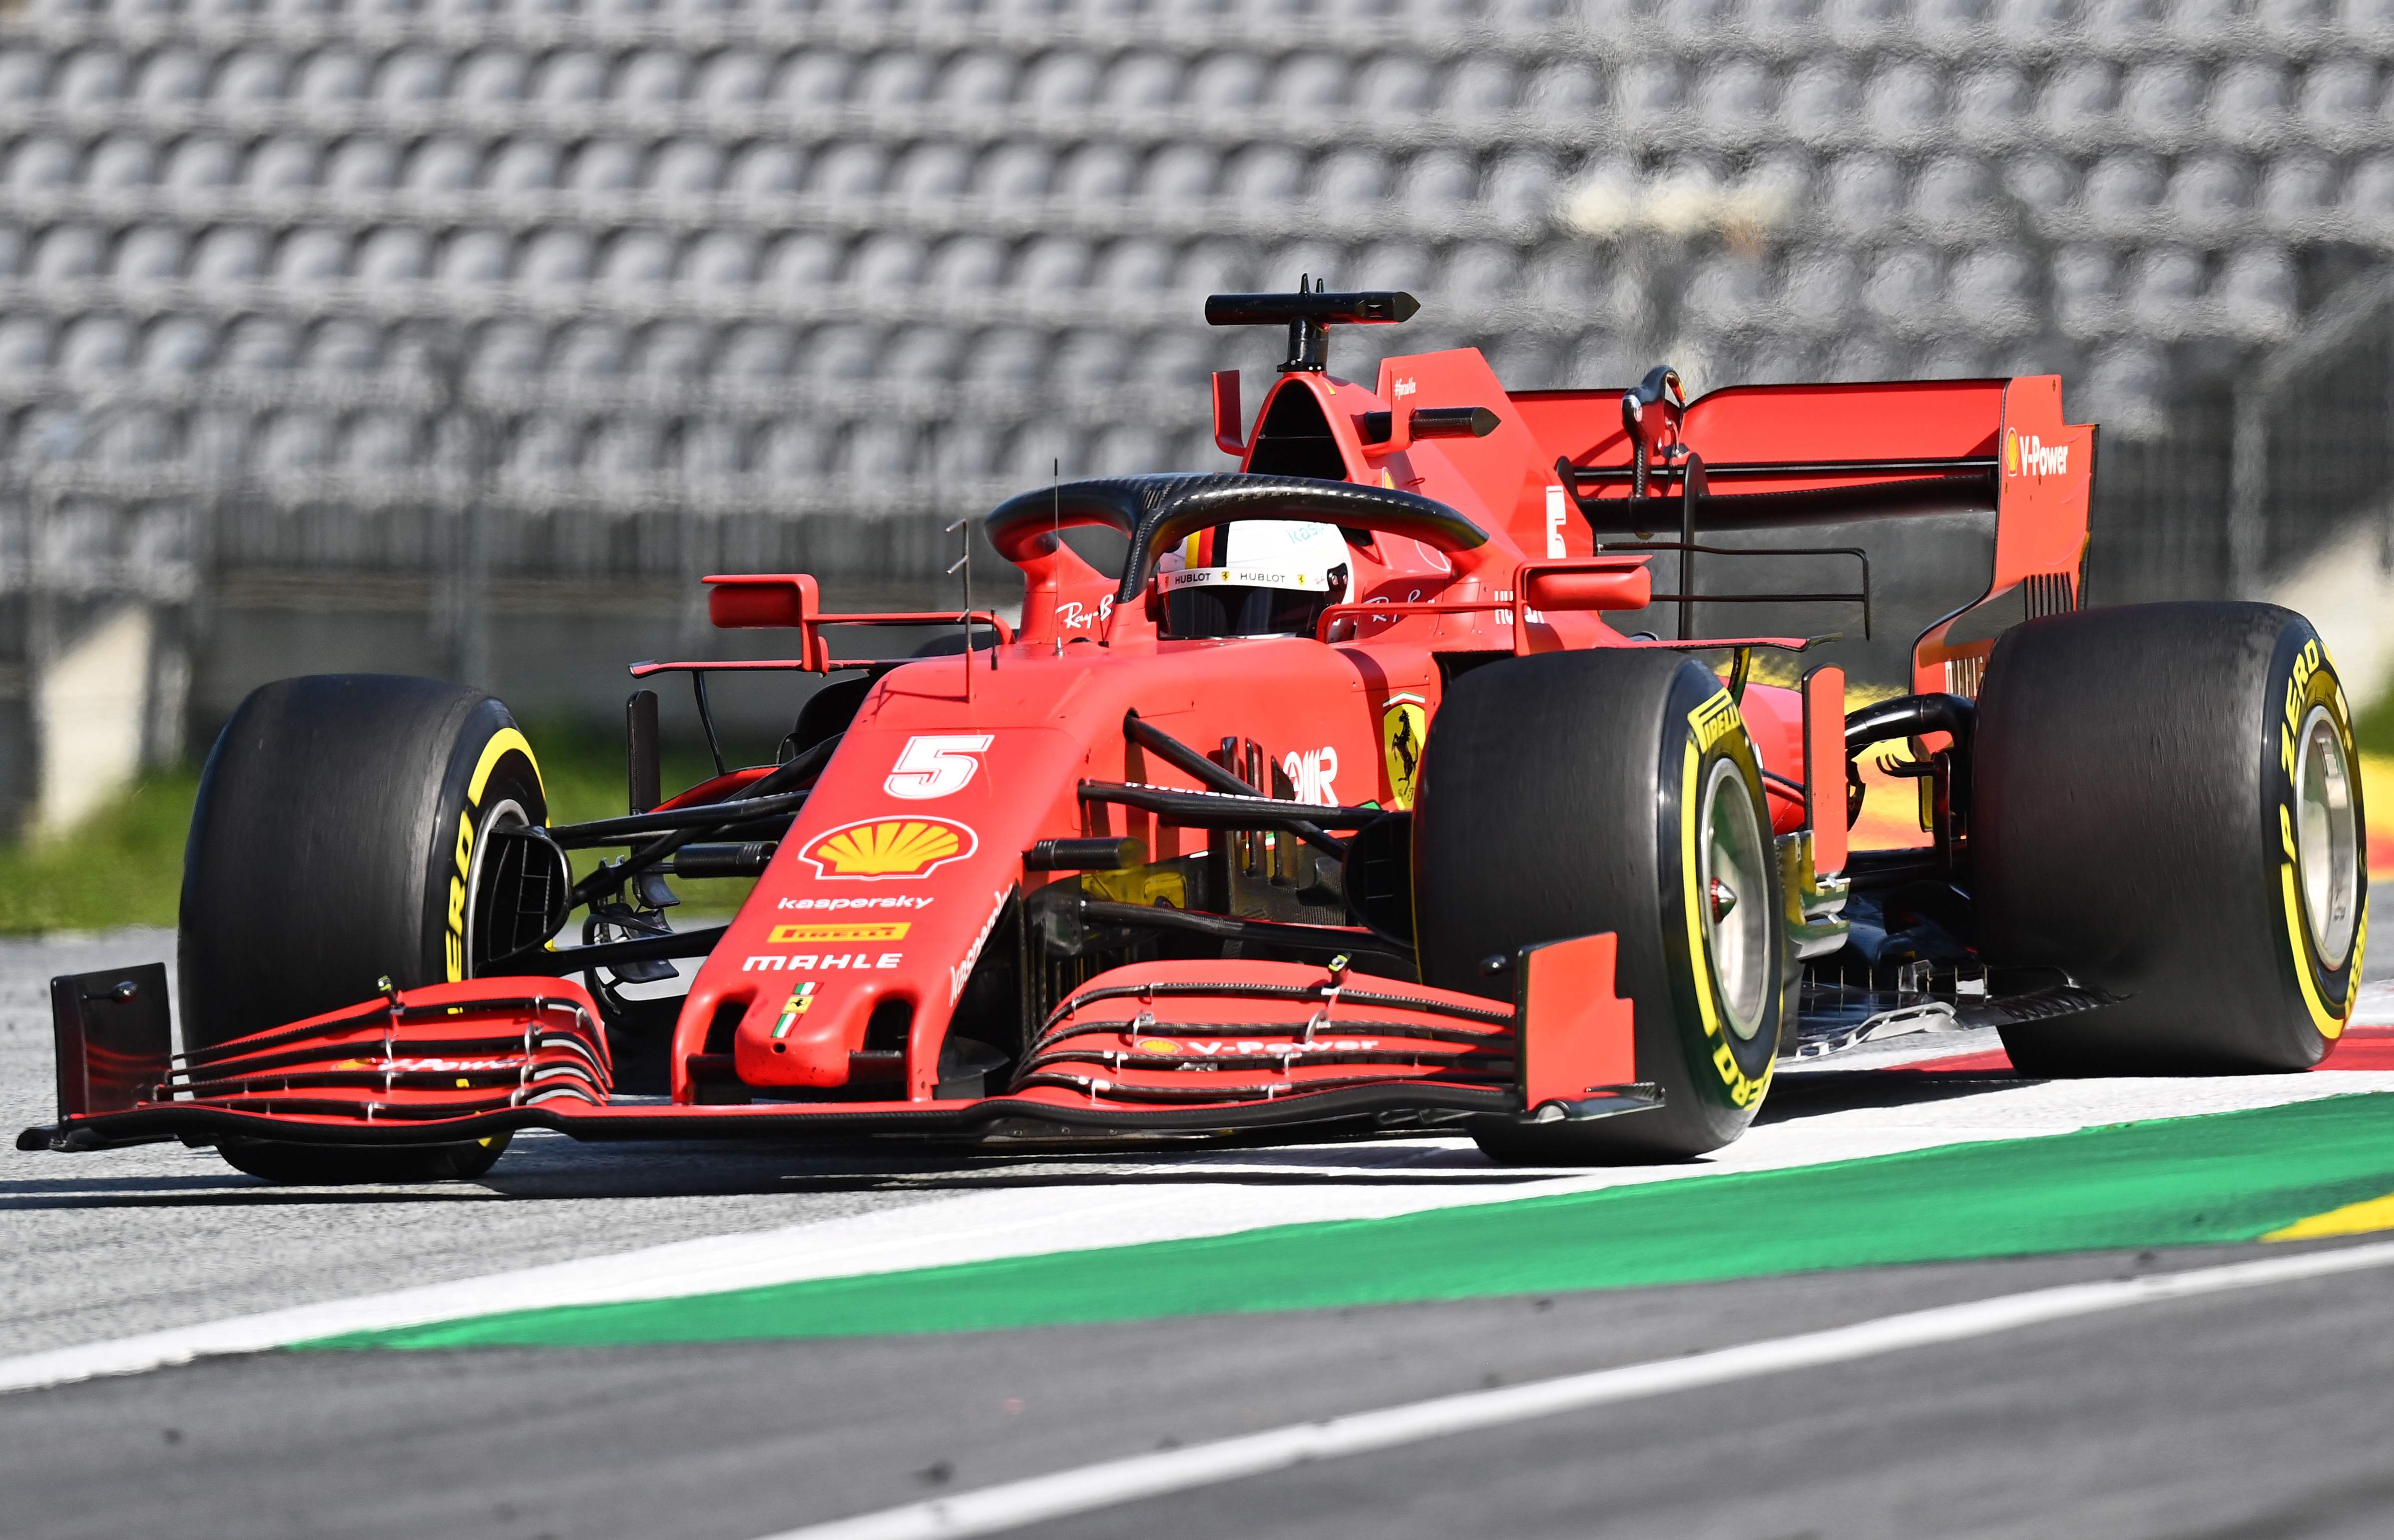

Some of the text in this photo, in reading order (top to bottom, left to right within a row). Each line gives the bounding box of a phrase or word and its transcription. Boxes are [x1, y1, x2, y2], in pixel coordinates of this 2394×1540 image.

[2019, 435, 2068, 477] V-Power
[1174, 572, 1212, 584] HUBLOT
[1240, 572, 1286, 583] HUBLOT
[1687, 686, 1741, 755] PIRELLI
[883, 734, 995, 800] 5
[445, 810, 474, 983] ERO
[777, 895, 935, 911] kaspersky
[742, 953, 903, 972] MAHLE
[1187, 1039, 1379, 1055] V-Power
